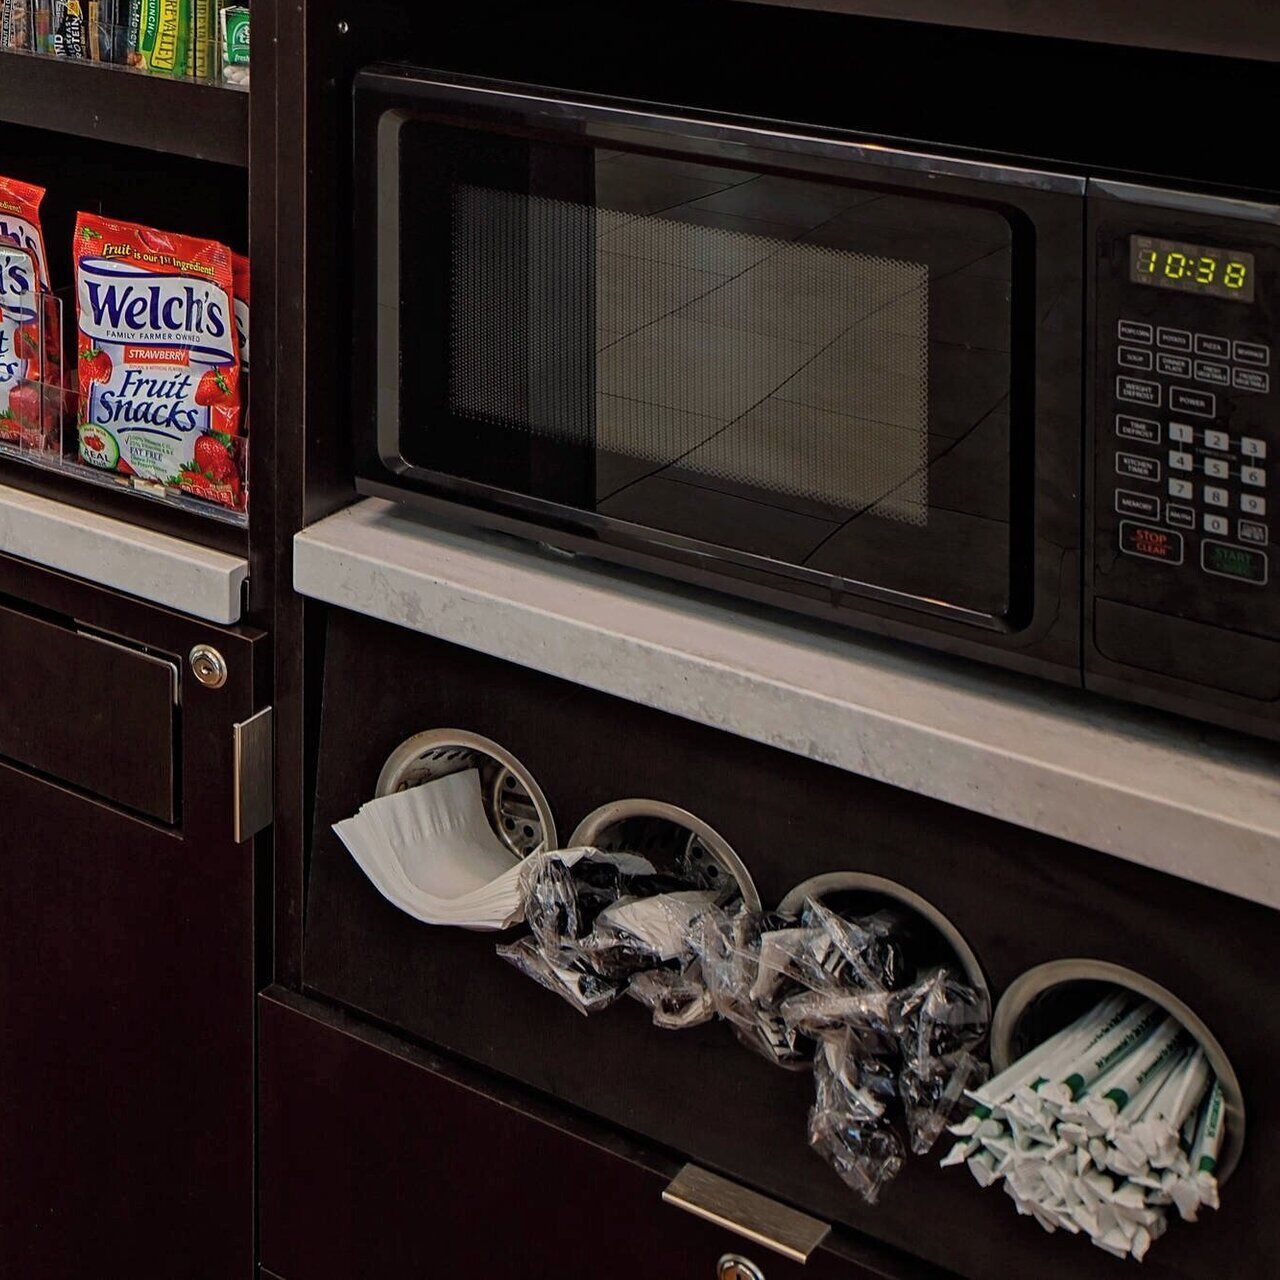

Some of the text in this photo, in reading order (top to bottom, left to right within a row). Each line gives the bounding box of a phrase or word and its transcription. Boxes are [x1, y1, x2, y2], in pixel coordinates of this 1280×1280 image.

[102, 242, 132, 261] Fruit
[142, 253, 159, 263] our
[1148, 251, 1246, 289] 10:38
[84, 279, 226, 338] Welch's
[106, 329, 201, 343] FAMILY FARMER OWNED
[128, 347, 186, 362] STRAWBERRY
[117, 369, 192, 400] Fruit
[96, 390, 200, 432] Snacks
[1136, 529, 1168, 545] STOP
